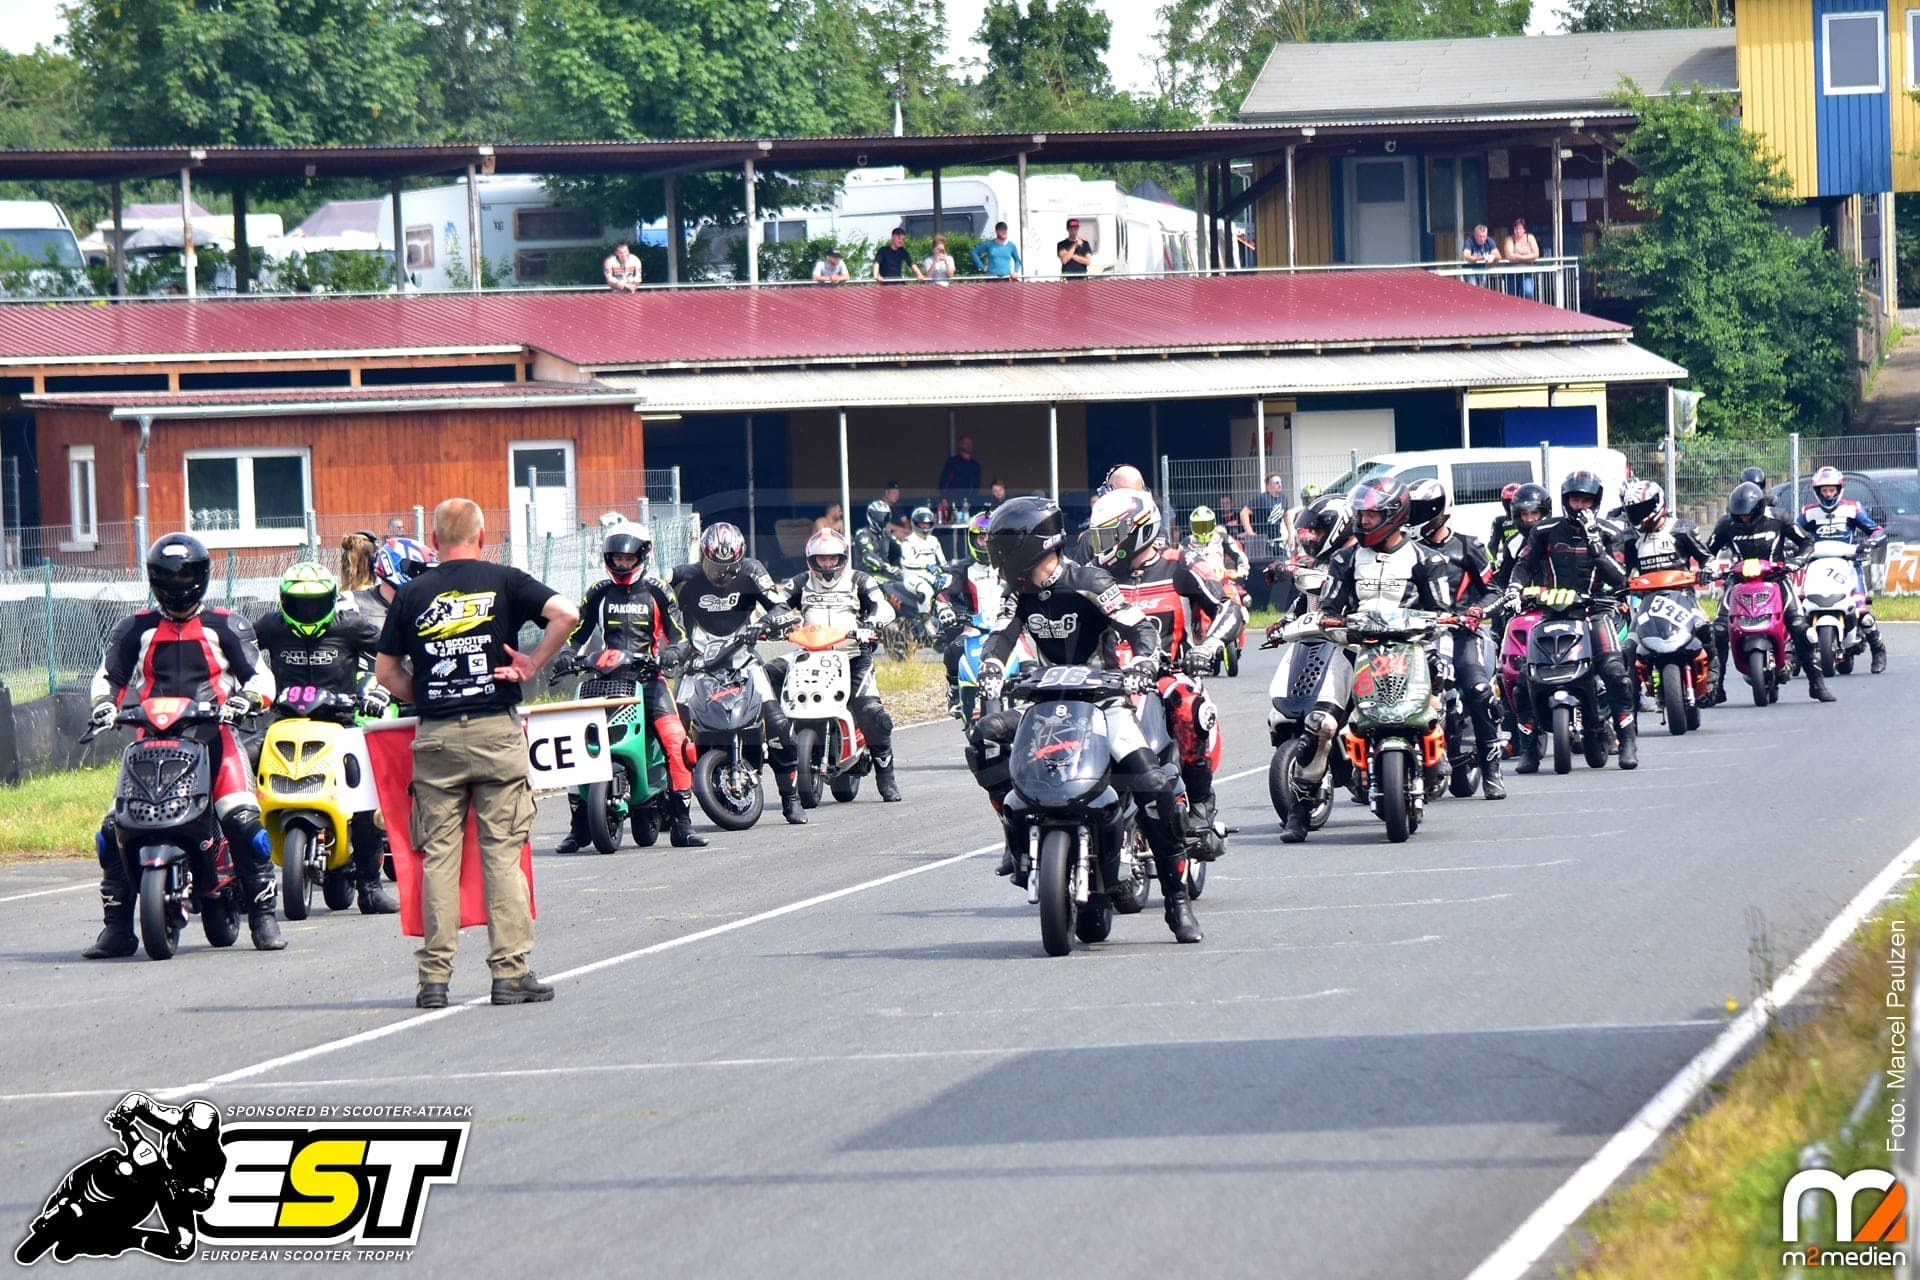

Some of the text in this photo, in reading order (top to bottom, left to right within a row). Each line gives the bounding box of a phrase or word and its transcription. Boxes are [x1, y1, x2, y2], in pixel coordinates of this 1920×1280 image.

[444, 634, 492, 648] SCOOTER
[446, 644, 483, 656] ATTACK
[1037, 665, 1092, 688] 96
[288, 686, 317, 702] 98
[529, 736, 575, 772] CE
